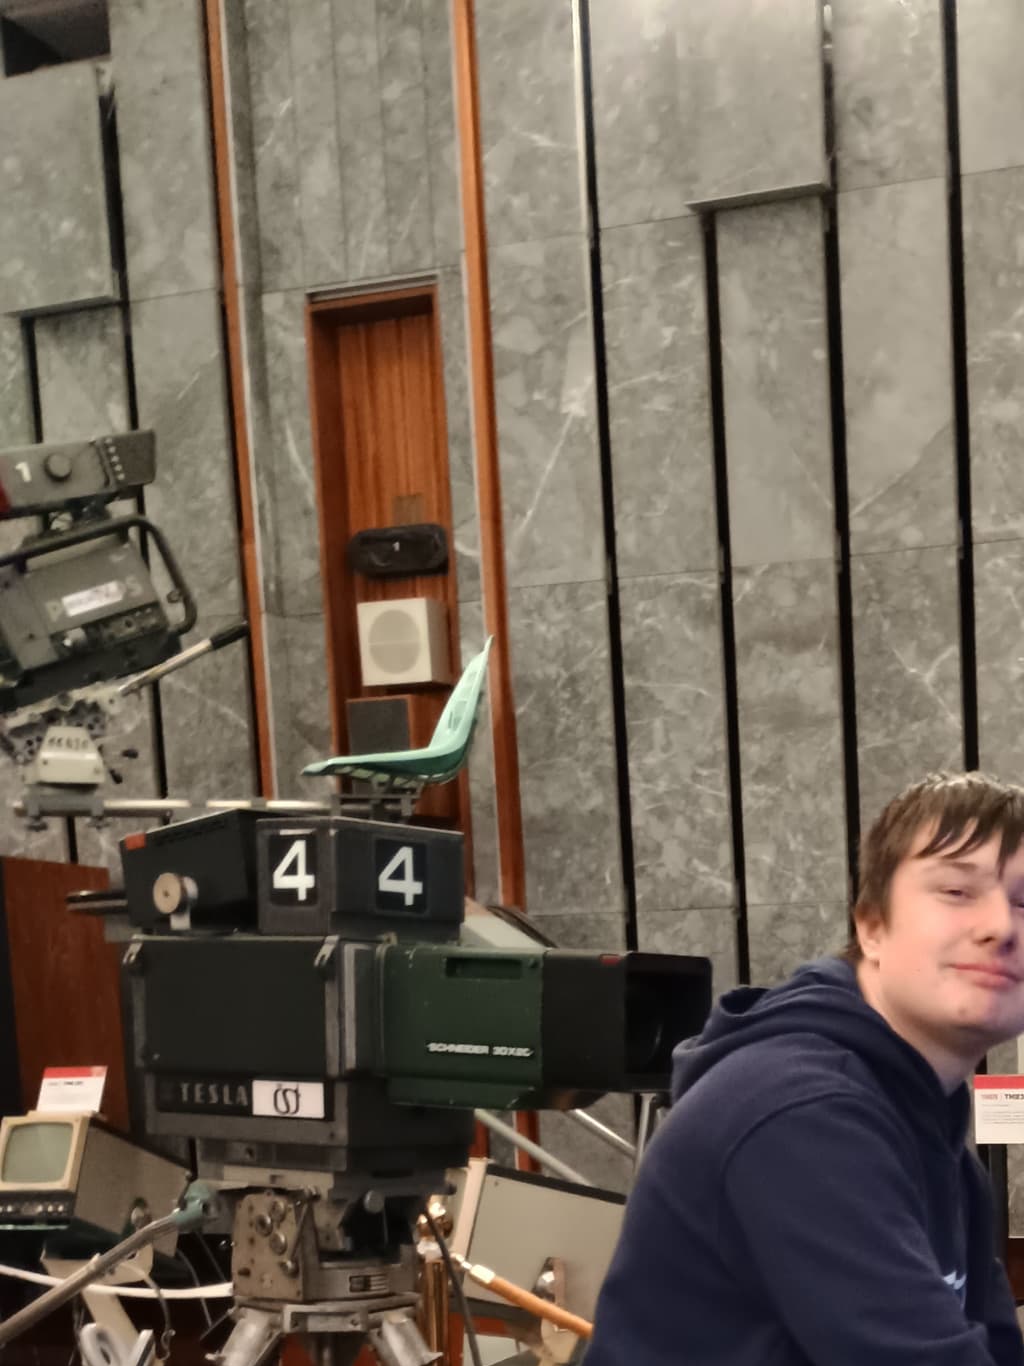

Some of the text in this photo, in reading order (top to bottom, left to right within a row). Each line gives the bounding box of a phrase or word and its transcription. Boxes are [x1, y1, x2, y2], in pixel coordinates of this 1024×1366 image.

[15, 462, 31, 482] 1
[273, 840, 315, 901] 4
[378, 846, 423, 906] 4
[180, 1083, 248, 1106] TESLA
